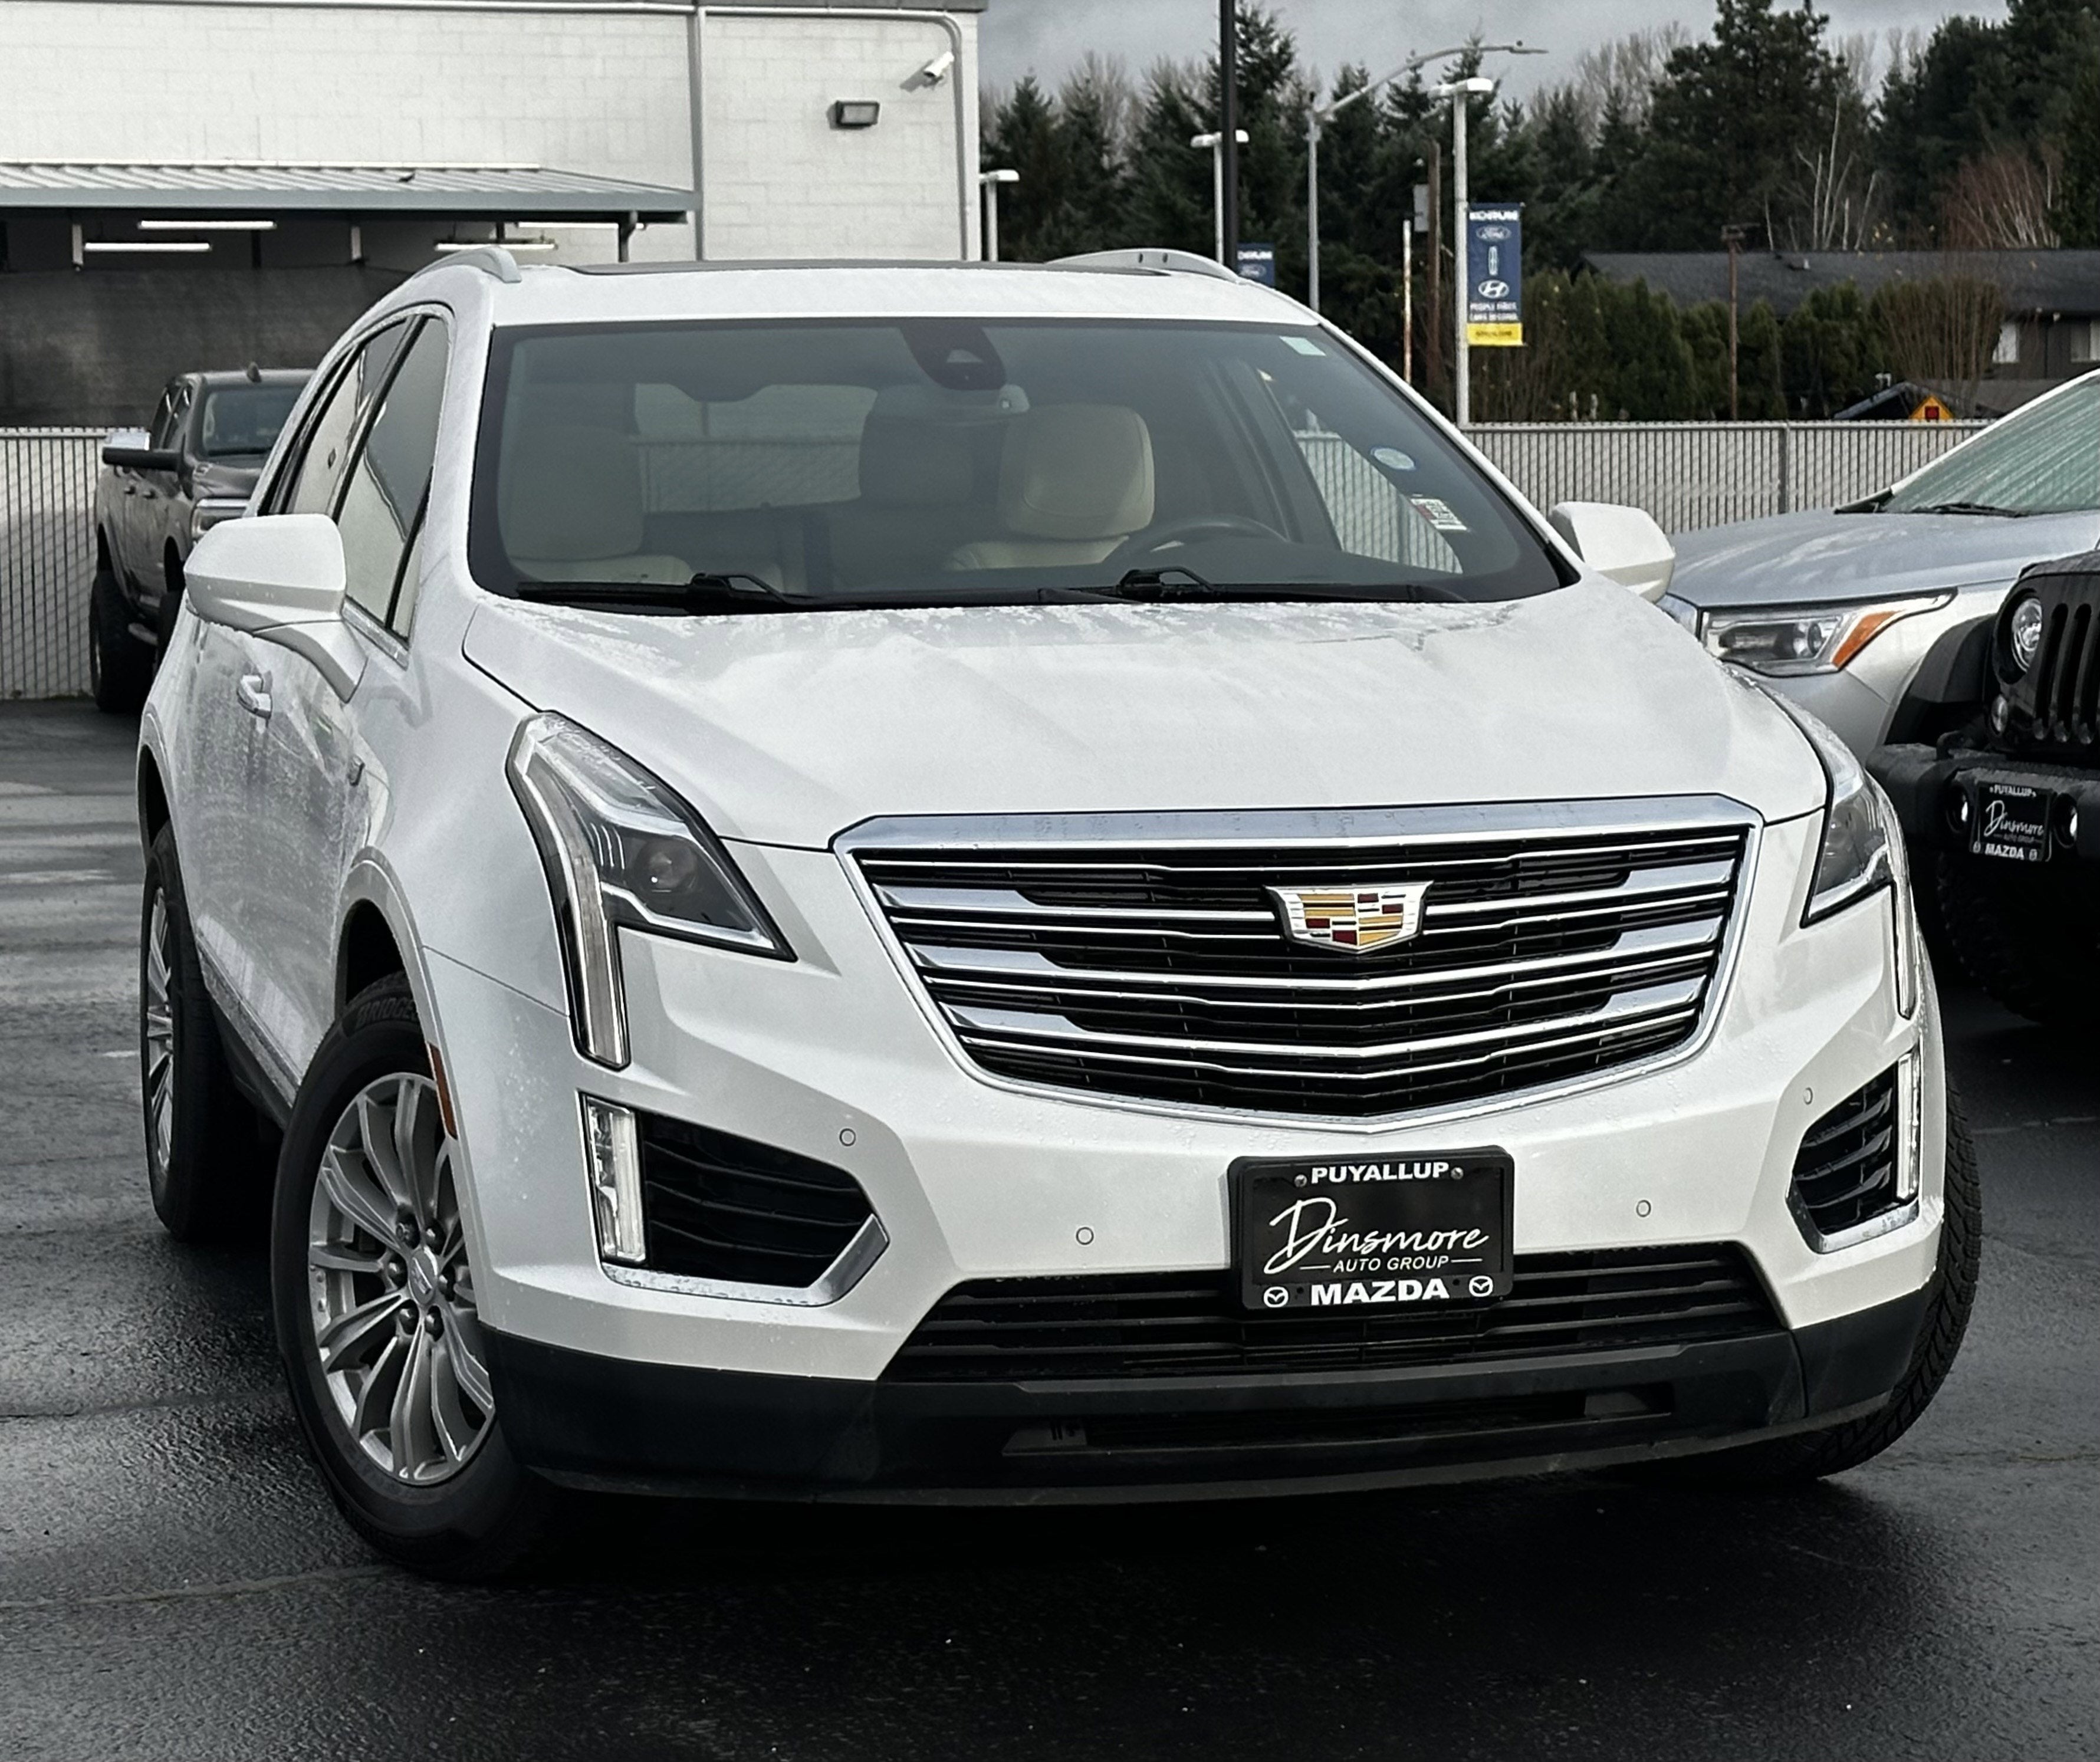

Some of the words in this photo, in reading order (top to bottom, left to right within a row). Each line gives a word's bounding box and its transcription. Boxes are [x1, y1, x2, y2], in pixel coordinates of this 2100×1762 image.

[1985, 843, 2025, 860] MAZDA
[1311, 1162, 1450, 1184] PUYALLUP
[1263, 1197, 1490, 1274] Dinsmore
[1333, 1260, 1381, 1273] AUTO
[1387, 1255, 1450, 1270] GROUP
[1310, 1278, 1450, 1306] MAZDA
